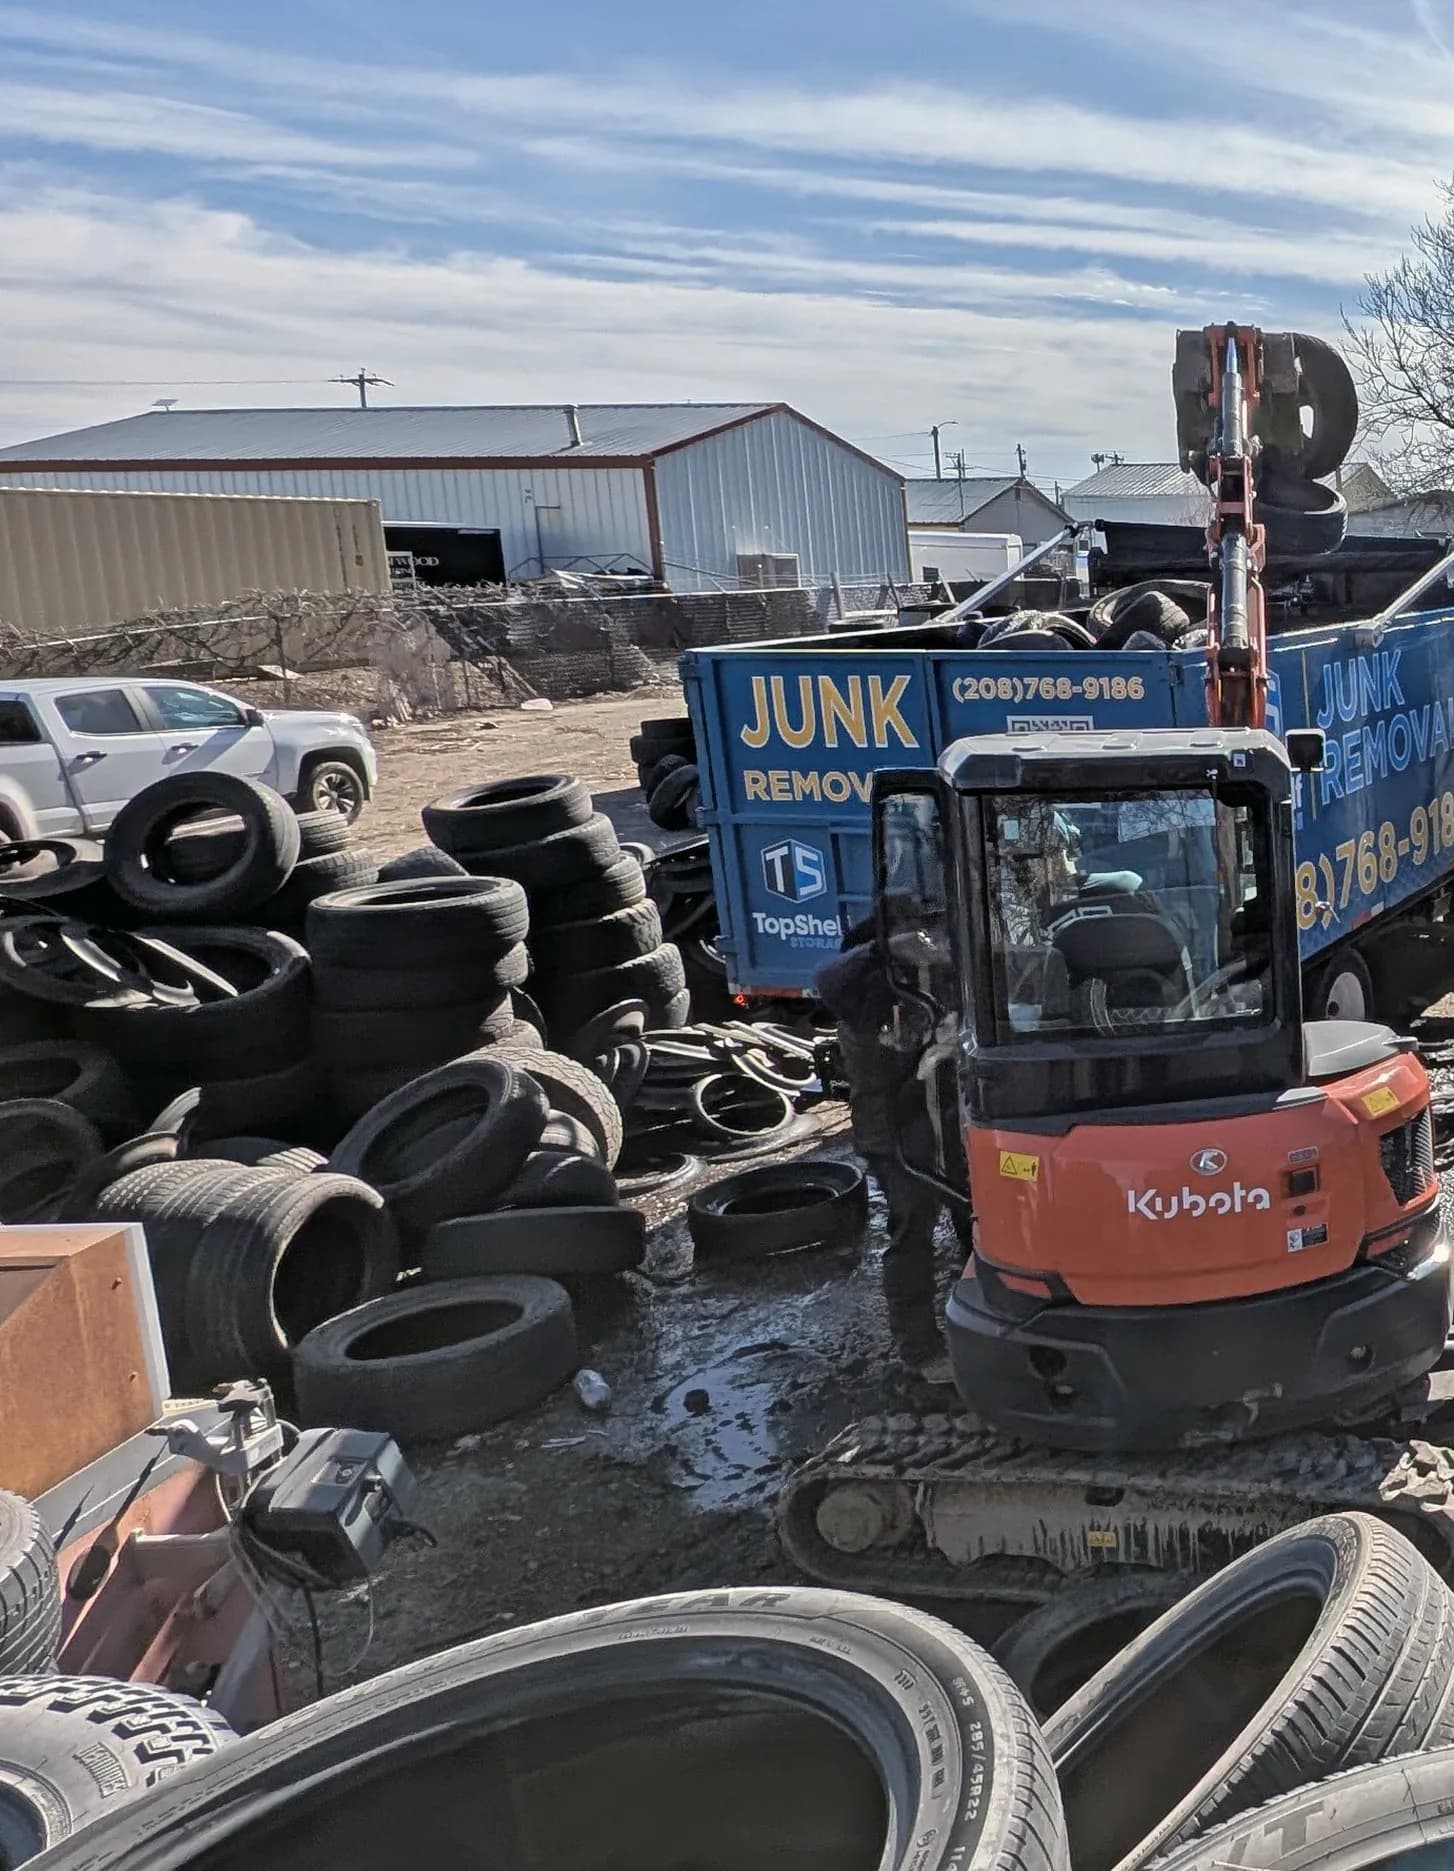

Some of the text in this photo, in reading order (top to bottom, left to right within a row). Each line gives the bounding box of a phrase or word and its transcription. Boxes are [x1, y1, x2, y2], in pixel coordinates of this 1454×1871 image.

[952, 676, 1145, 703] (208)768-9186
[1316, 648, 1405, 730] JUNK
[740, 675, 919, 749] JUNK
[744, 770, 873, 802] REMOV
[752, 912, 848, 940] TopShel
[1128, 1182, 1270, 1220] Kubota
[964, 1721, 985, 1822] 285/45R22
